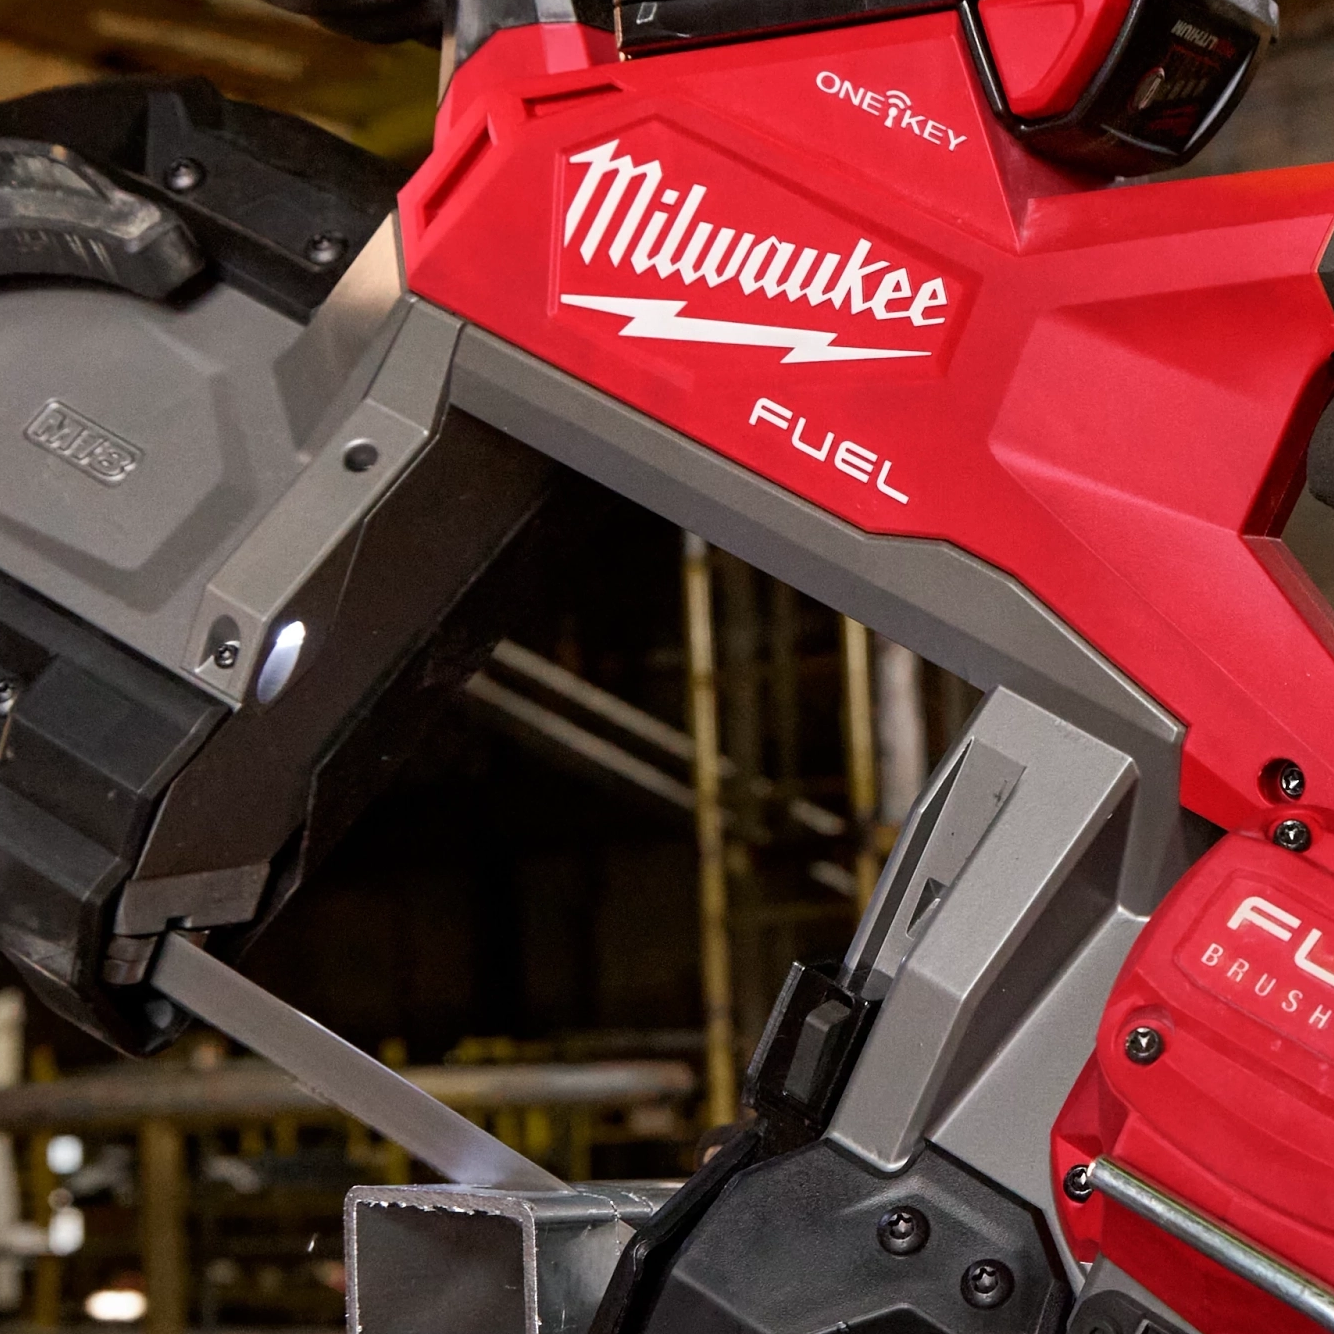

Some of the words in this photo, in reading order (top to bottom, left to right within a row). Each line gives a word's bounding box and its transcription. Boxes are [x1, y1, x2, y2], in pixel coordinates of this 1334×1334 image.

[815, 70, 885, 116] ONE
[900, 109, 968, 151] KEY
[563, 139, 948, 327] Milwaukee
[31, 406, 136, 480] M18
[748, 397, 910, 504] FUEL
